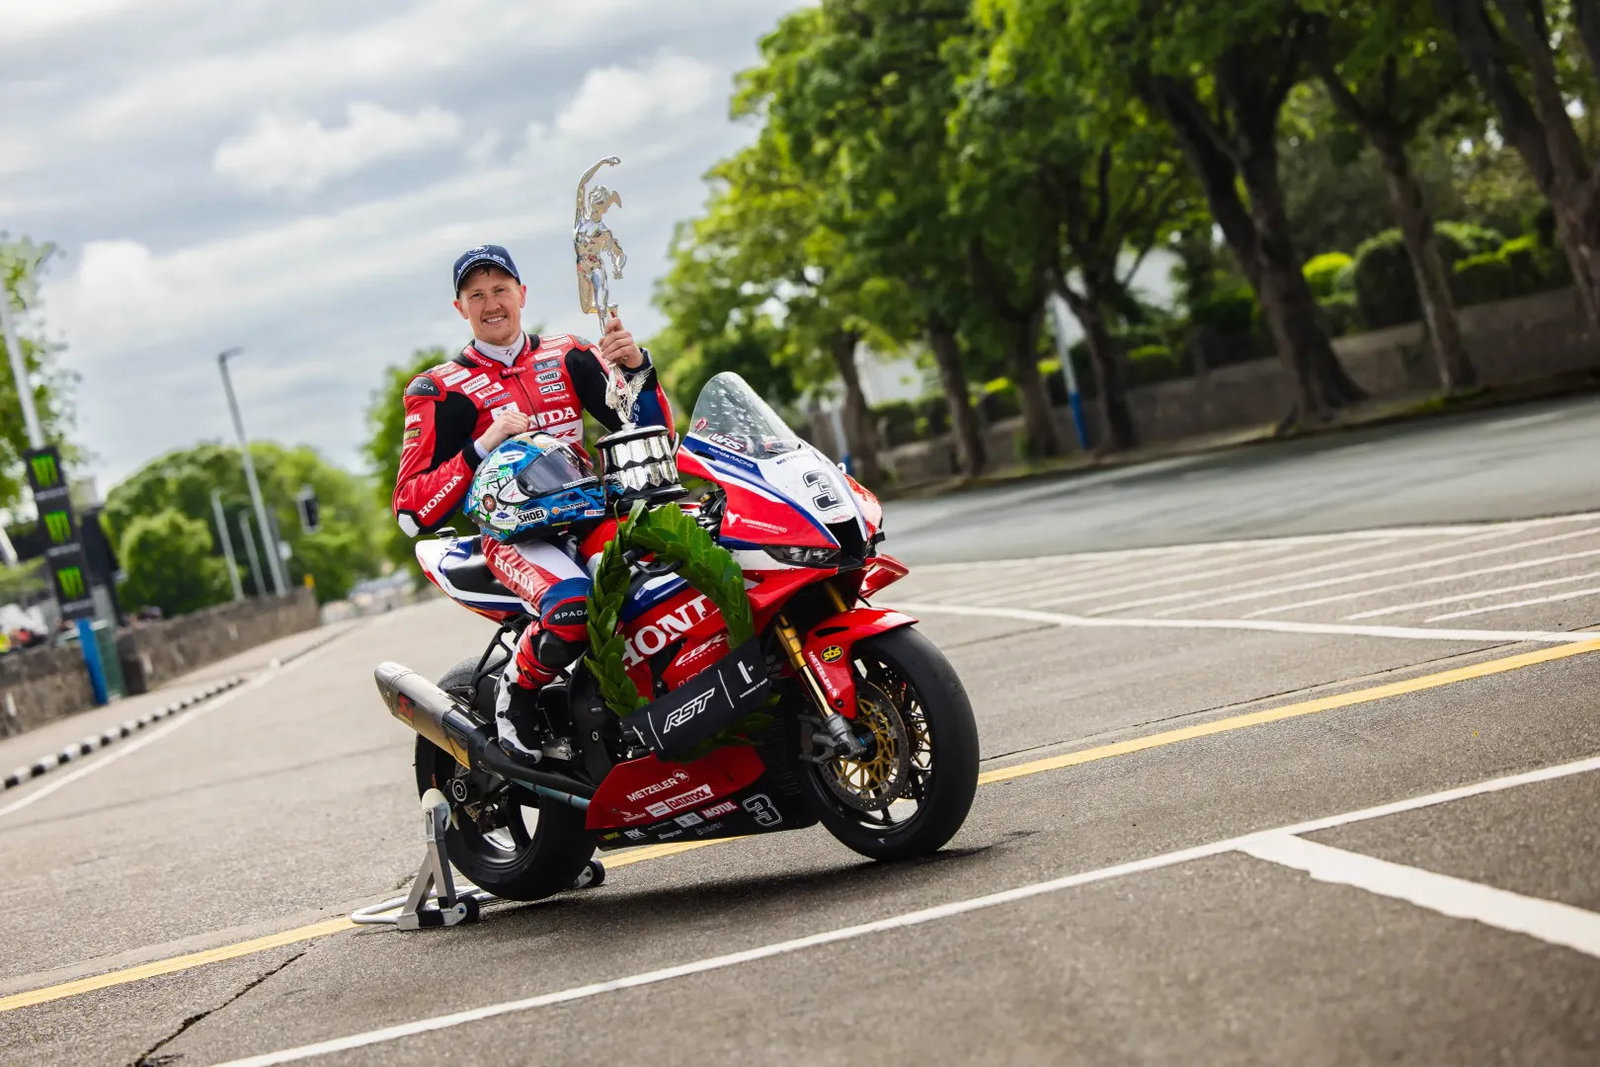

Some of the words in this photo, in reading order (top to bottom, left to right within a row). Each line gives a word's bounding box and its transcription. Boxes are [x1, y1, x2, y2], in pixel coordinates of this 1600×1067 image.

[539, 372, 558, 382] SHOEI
[540, 384, 566, 394] SIDI
[480, 384, 497, 396] RK
[528, 406, 577, 430] NDA
[710, 432, 746, 451] WRS
[417, 474, 464, 518] HONDA
[803, 469, 848, 512] 3
[518, 512, 545, 525] SHOEI
[493, 553, 534, 595] HONDA
[808, 650, 834, 690] METZELER
[663, 687, 716, 734] RST
[626, 777, 679, 802] METZELER
[702, 801, 738, 819] MOTUL
[742, 793, 783, 828] 3
[624, 828, 646, 839] RK
